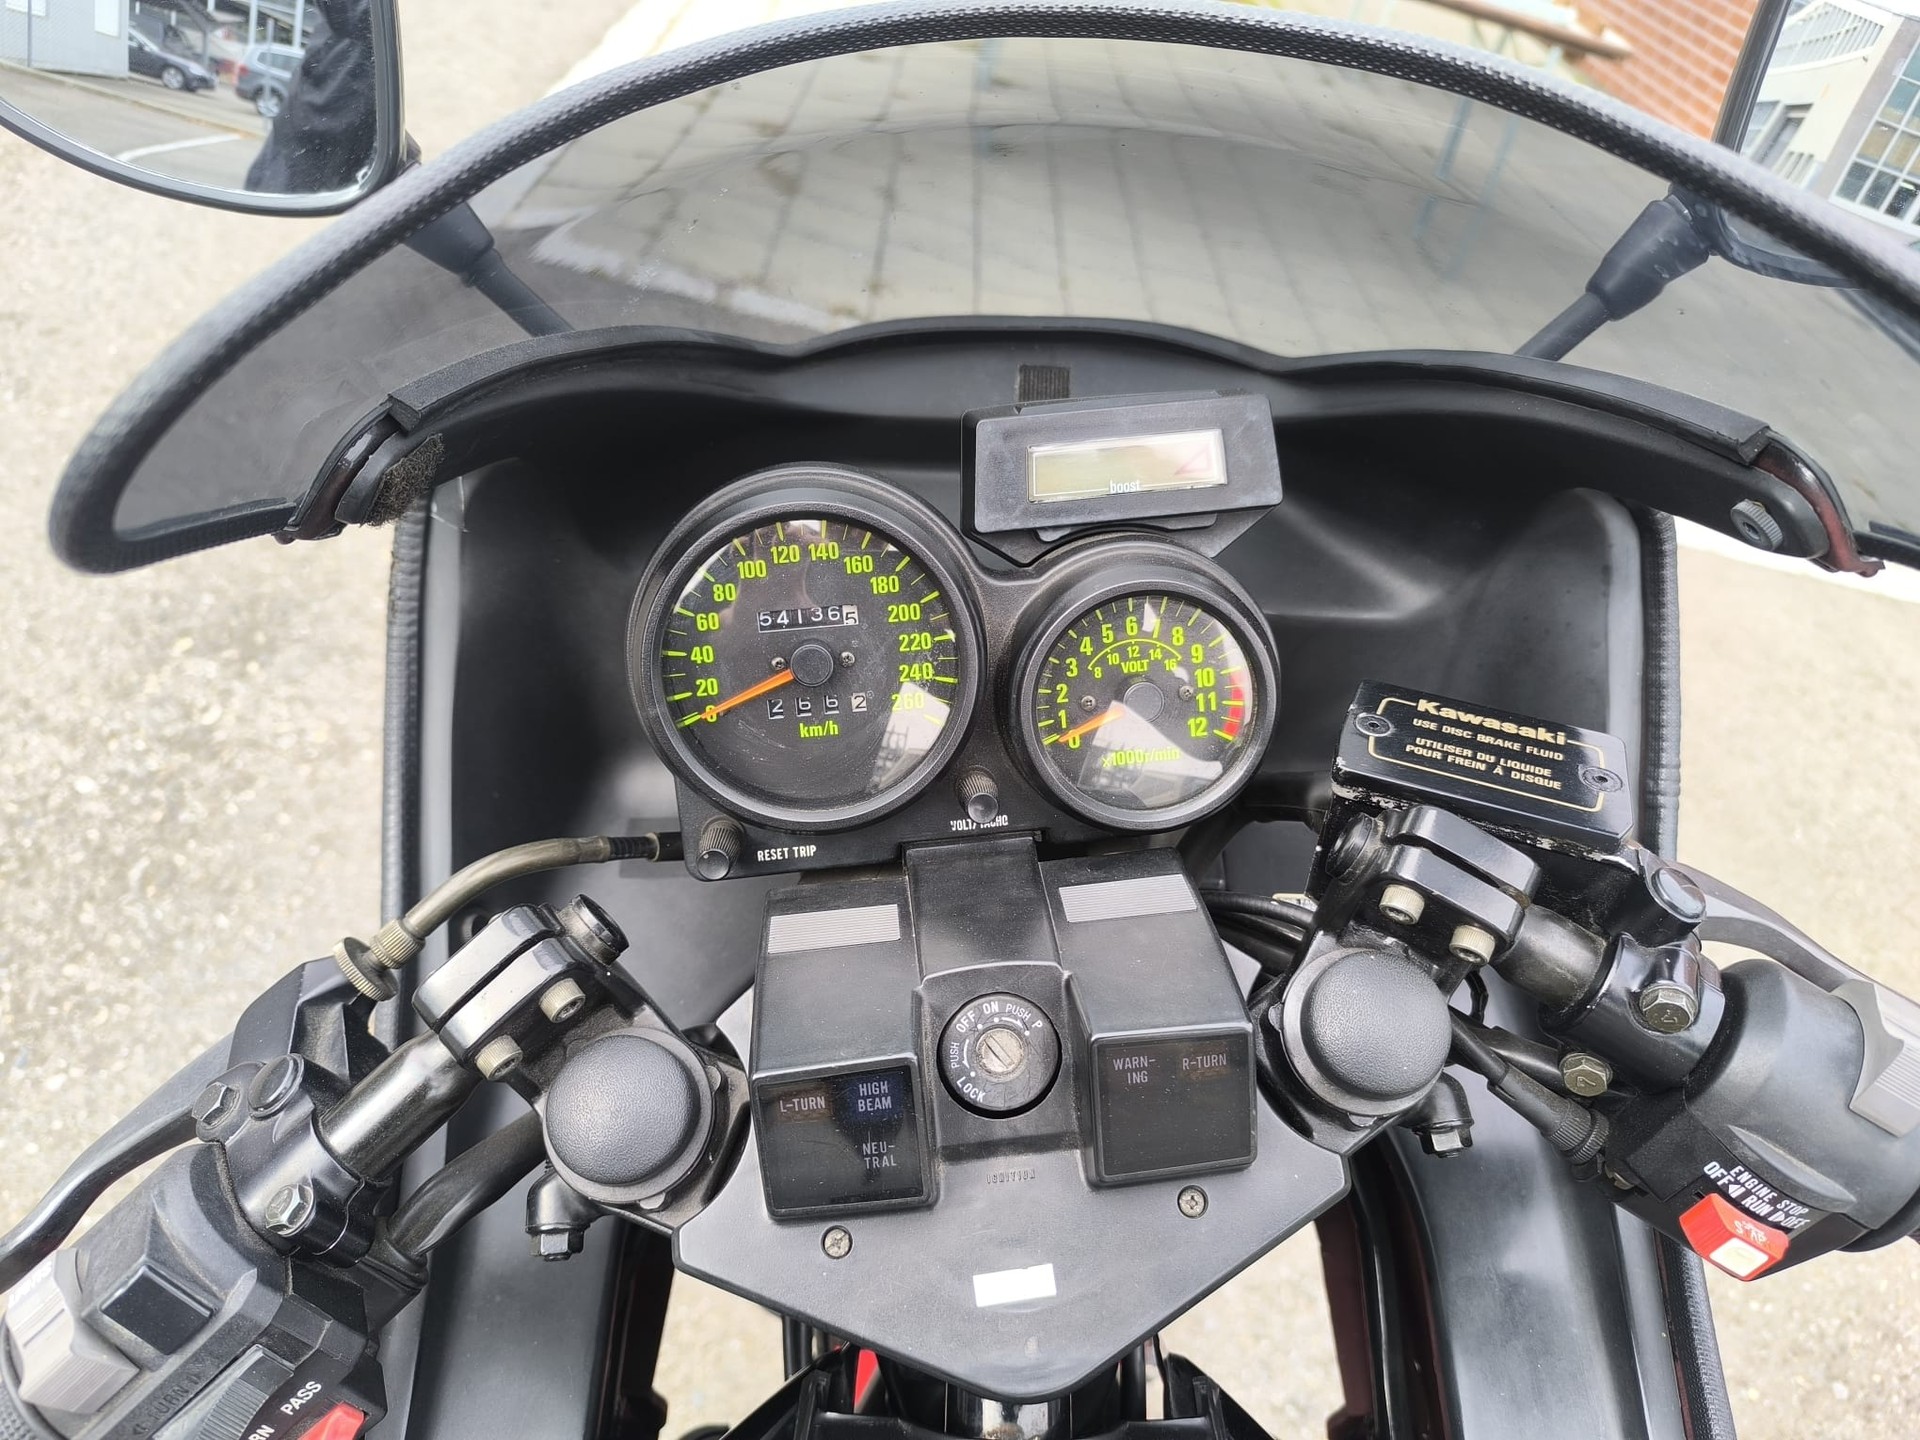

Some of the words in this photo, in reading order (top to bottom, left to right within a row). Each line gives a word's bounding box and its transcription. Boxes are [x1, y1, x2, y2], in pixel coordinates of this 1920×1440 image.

[1110, 480, 1141, 494] boost
[770, 544, 801, 564] 120
[808, 541, 839, 562] 140
[736, 560, 768, 579] 100
[844, 554, 874, 575] 160
[713, 583, 737, 603] 80
[870, 575, 899, 595] 180
[696, 612, 721, 631] 60
[887, 603, 922, 624] 200
[1101, 624, 1114, 644] 5
[1126, 616, 1138, 636] 6
[1151, 618, 1161, 639] 7
[1172, 626, 1184, 646] 8
[898, 632, 933, 653] 220
[1080, 637, 1093, 656] 4
[1127, 646, 1140, 658] 12
[690, 645, 715, 664] 40
[1106, 653, 1120, 665] 10
[1149, 648, 1162, 660] 14
[1191, 644, 1204, 664] 9
[899, 662, 934, 683] 240
[1066, 658, 1078, 678] 3
[1094, 667, 1102, 679] 8
[1120, 659, 1150, 674] VOLT
[1164, 658, 1177, 671] 16
[695, 678, 719, 698] 20
[1194, 668, 1216, 688] 10
[891, 692, 925, 713] 260
[1056, 684, 1068, 703] 2
[1196, 692, 1217, 713] 11
[799, 720, 840, 738] km/h
[1058, 710, 1067, 729] 1
[1188, 717, 1208, 738] 12
[1416, 699, 1567, 746] Kawasaki
[1413, 718, 1438, 731] USE
[1442, 724, 1472, 739] DISC
[1477, 733, 1522, 752] BRAKE
[1525, 744, 1564, 762] FLUID
[1415, 737, 1473, 759] UTILISER
[1476, 750, 1496, 764] DU
[1499, 757, 1552, 777] LIQUIDE
[1405, 745, 1442, 760] POUR
[1447, 754, 1486, 772] FREIN
[1510, 769, 1562, 790] DISQUE
[757, 848, 788, 862] RESET
[790, 845, 817, 860] TRIP
[955, 1010, 976, 1033] OFF
[982, 1001, 999, 1014] ON
[1005, 1003, 1031, 1020] PUSH
[1032, 1020, 1043, 1029] P
[950, 1042, 960, 1069] PUSH
[1182, 1054, 1227, 1070] R-TURN
[1127, 1070, 1148, 1084] ING
[859, 1081, 889, 1097] HIGH
[956, 1076, 986, 1103] LOCK
[780, 1096, 826, 1113] L-TURN
[858, 1096, 892, 1112] BEAM
[864, 1155, 897, 1170] TRAL
[1703, 1161, 1735, 1186] OFF
[1729, 1165, 1778, 1202] ENGINE
[1776, 1199, 1809, 1216] STOP
[1741, 1195, 1776, 1217] RUN
[1781, 1216, 1811, 1230] OFF
[280, 1381, 322, 1416] PASS
